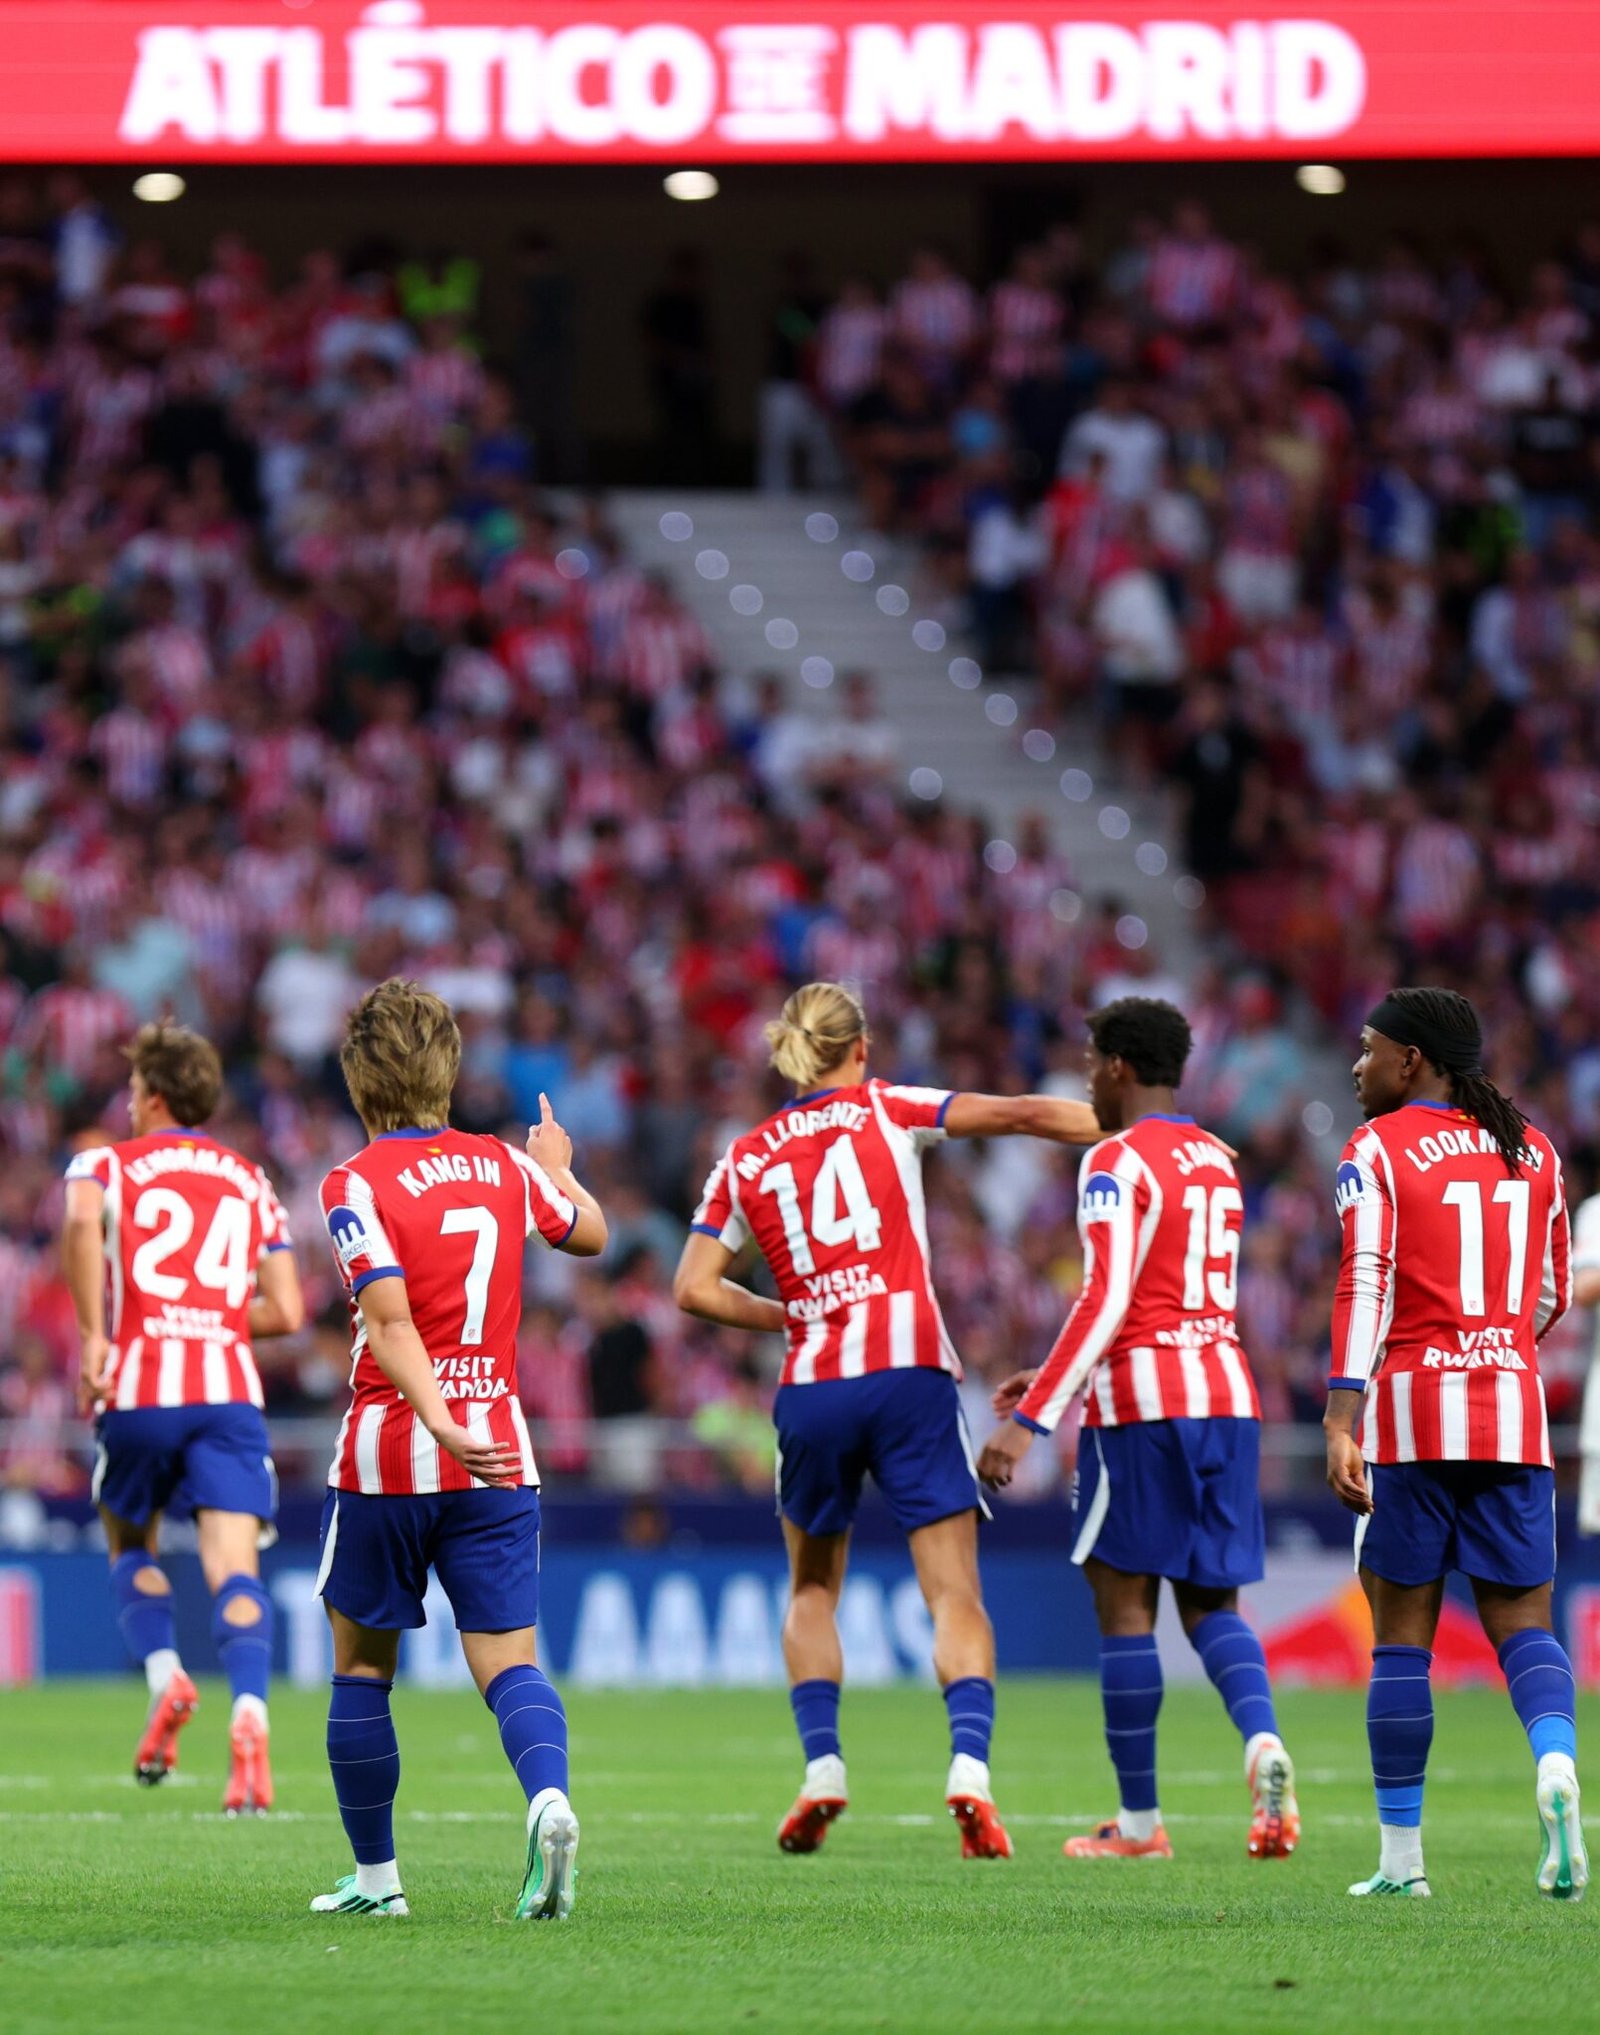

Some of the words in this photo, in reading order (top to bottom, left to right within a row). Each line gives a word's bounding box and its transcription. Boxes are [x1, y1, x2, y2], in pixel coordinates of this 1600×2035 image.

[118, 0, 718, 143] ATLÉTICO
[843, 19, 1366, 141] MADRID
[396, 1154, 472, 1199] KANG
[472, 1155, 501, 1188] IN
[736, 1152, 771, 1181] M.
[762, 1101, 872, 1153] LLORENTE
[132, 1187, 252, 1309] 24
[759, 1134, 882, 1276] 14
[1182, 1186, 1244, 1311] 15
[1441, 1180, 1529, 1316] 11
[440, 1206, 498, 1345] 7
[803, 1263, 870, 1298] VISIT
[433, 1356, 496, 1378] VISIT
